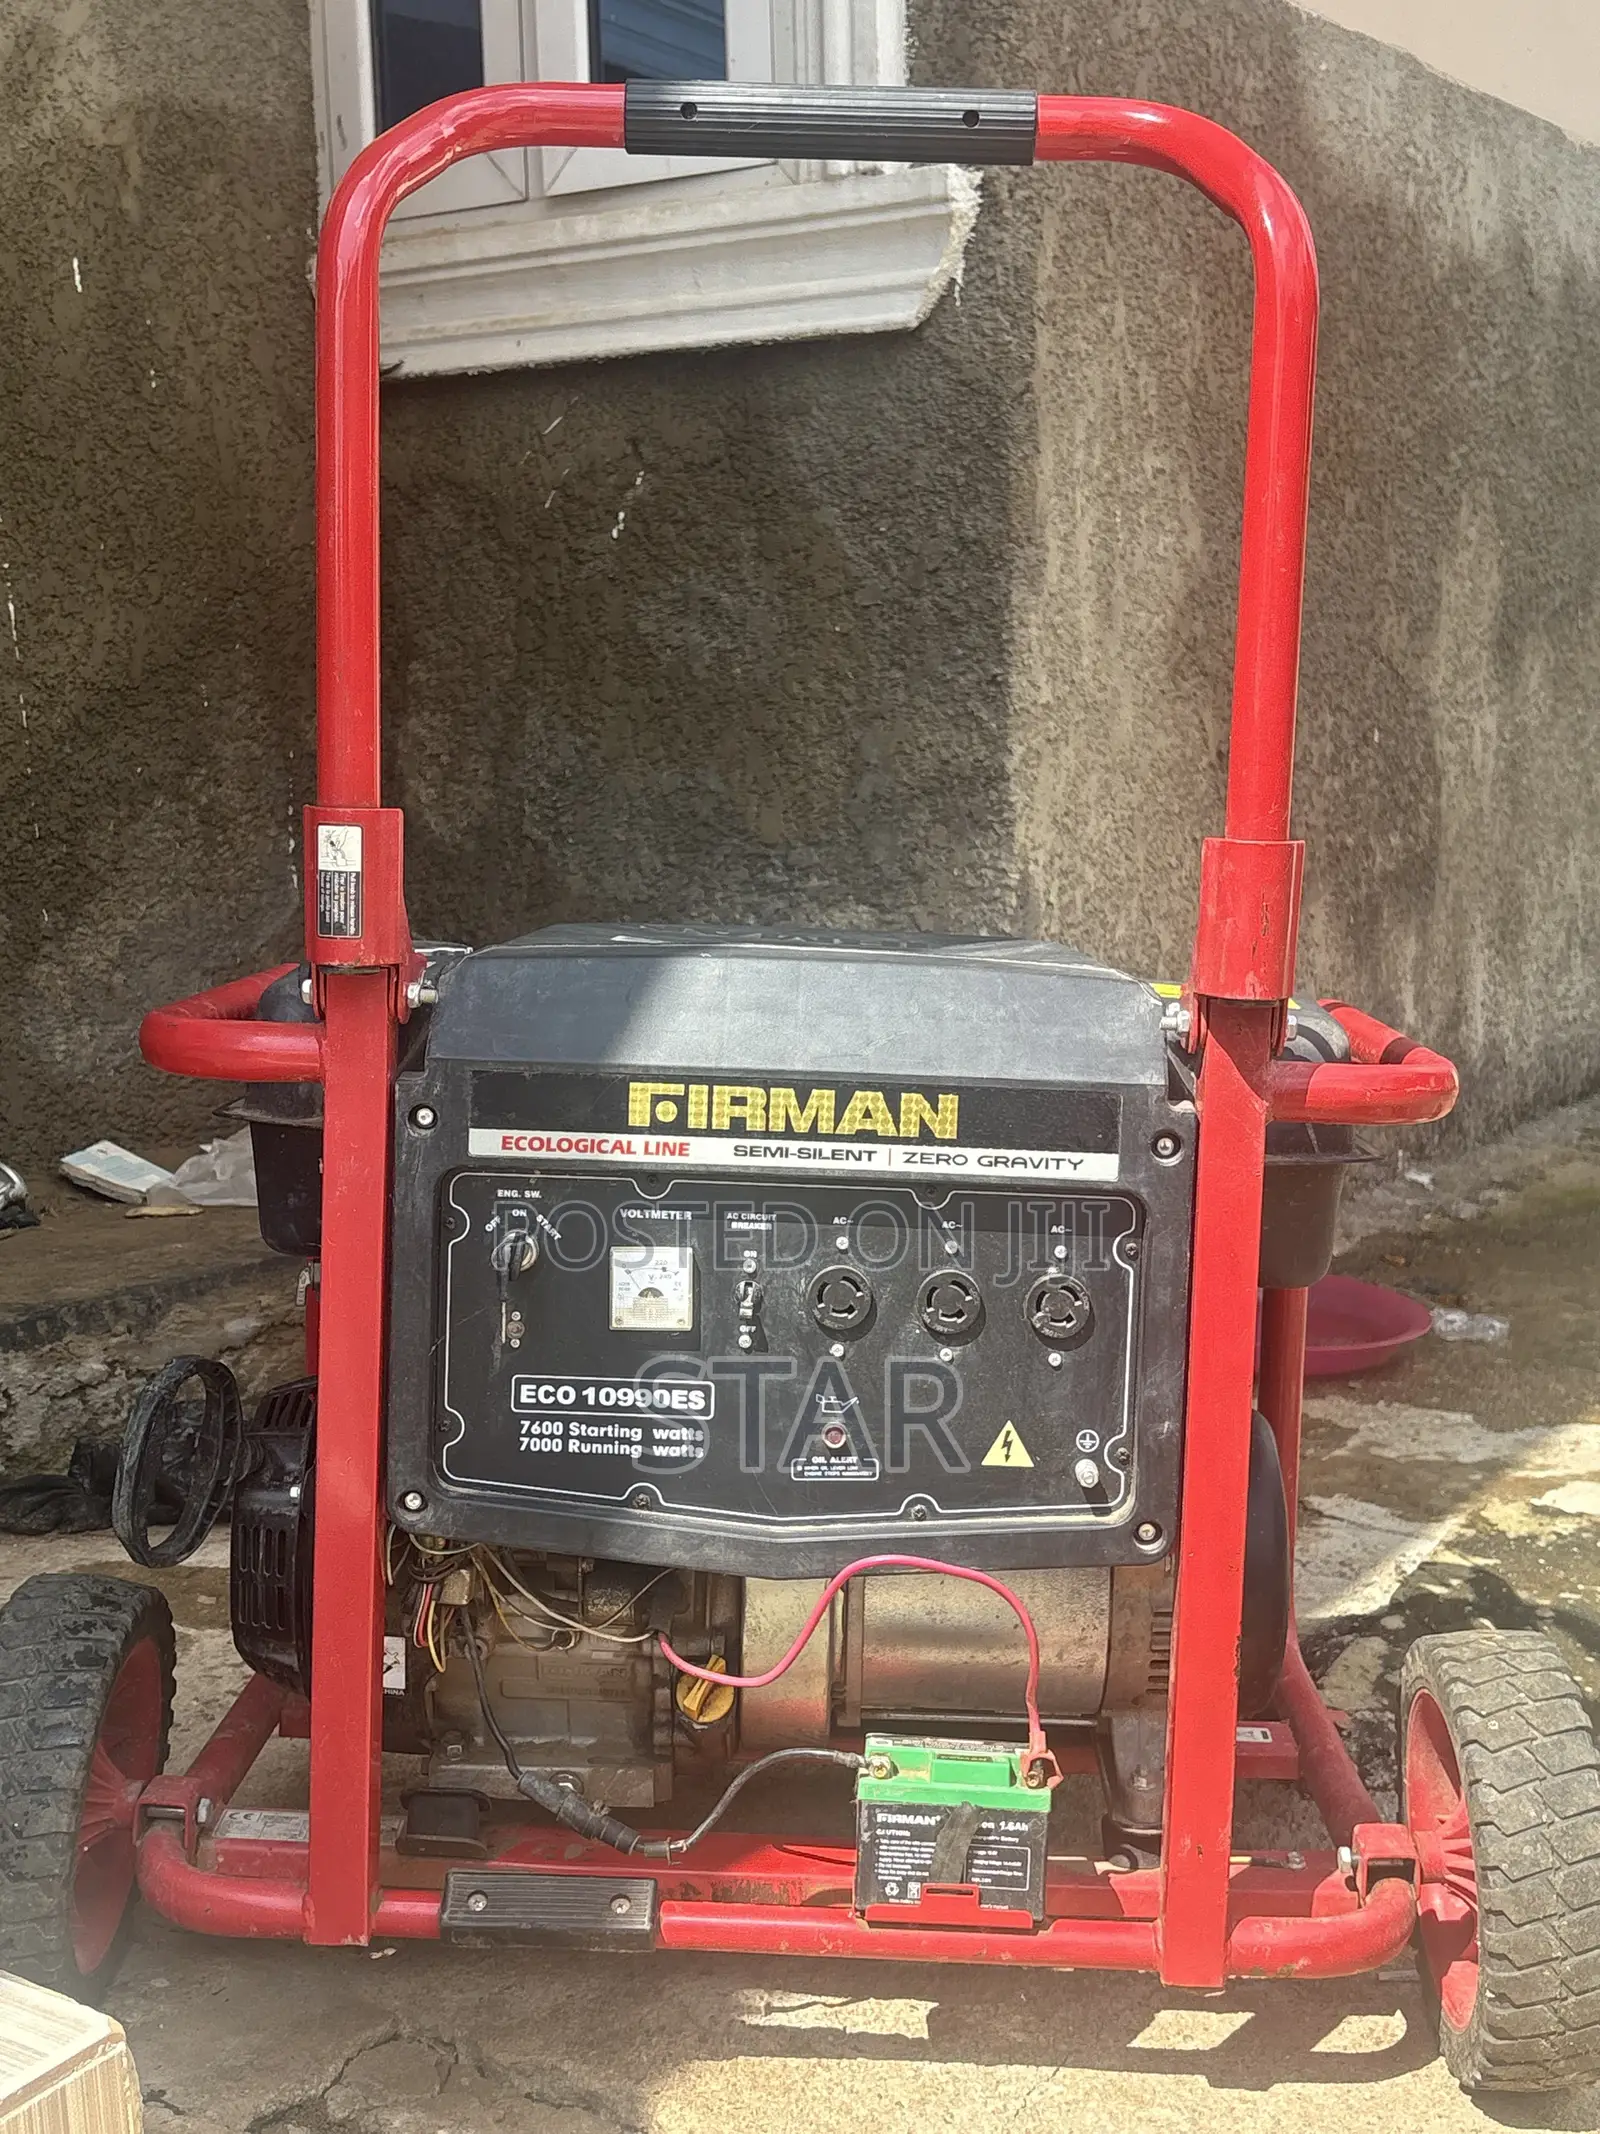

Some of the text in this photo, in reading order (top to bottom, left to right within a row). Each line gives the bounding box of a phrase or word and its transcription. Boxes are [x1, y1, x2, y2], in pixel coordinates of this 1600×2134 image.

[628, 1082, 959, 1139] FIRMAN
[501, 1135, 690, 1157] ECOLOGICAL LINE
[733, 1144, 1084, 1170] SEMI-SILENT ZERO GRAVITY
[497, 1190, 542, 1198] ENG. SW.
[512, 1209, 527, 1217] ON
[619, 1208, 693, 1220] VOLTMETER
[740, 1213, 777, 1221] CIRCUIT
[485, 1215, 501, 1232] OFF
[536, 1214, 562, 1241] START
[731, 1222, 772, 1230] BREAKER
[739, 1325, 756, 1333] OFF
[519, 1384, 706, 1410] ECO 10990ES
[519, 1420, 704, 1441] 7600 Starting watts
[519, 1437, 704, 1459] 7000 Running watts
[811, 1456, 858, 1464] OIL ALERT
[384, 1688, 405, 1696] HINA
